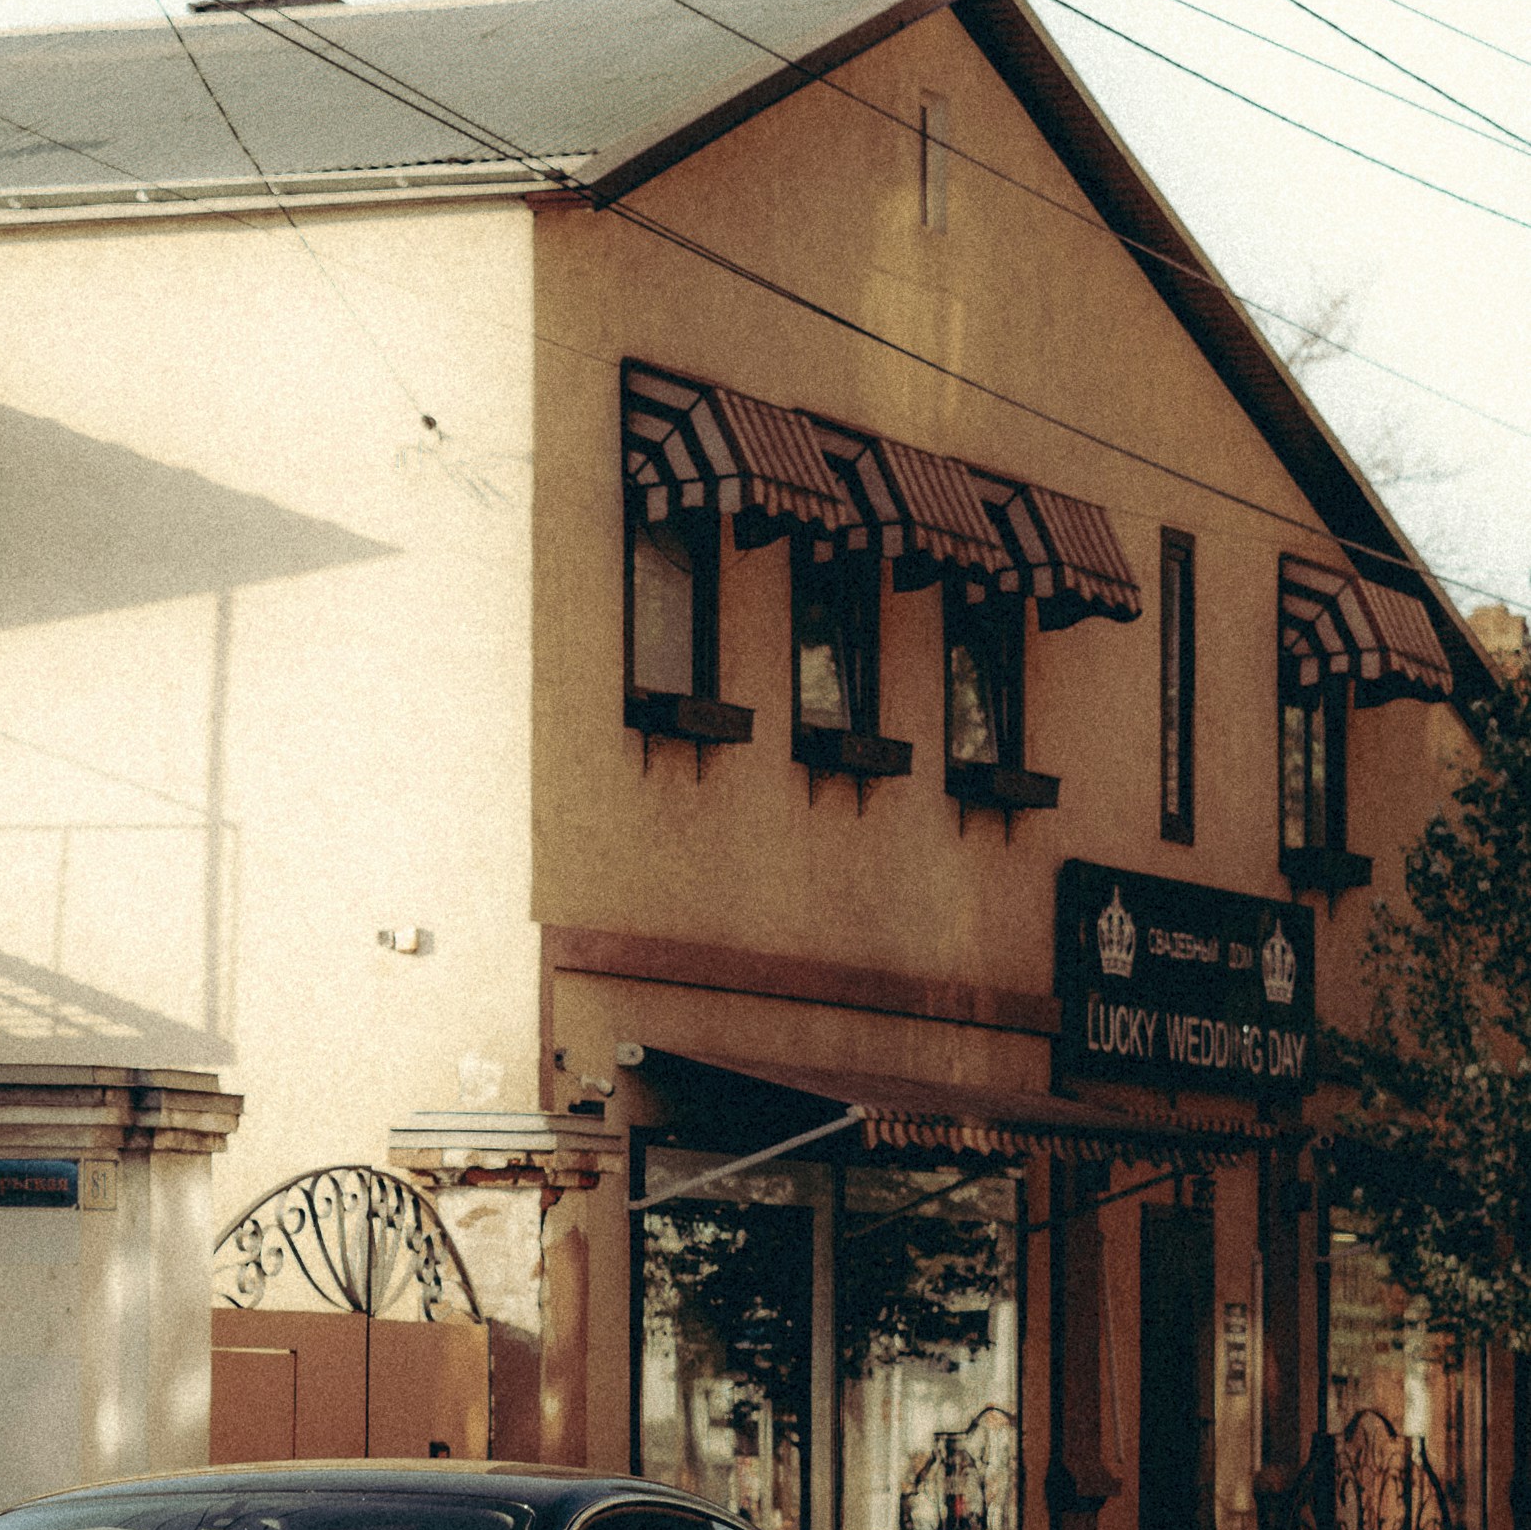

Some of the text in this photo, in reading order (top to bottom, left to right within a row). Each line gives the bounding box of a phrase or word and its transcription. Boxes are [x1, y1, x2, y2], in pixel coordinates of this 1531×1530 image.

[1088, 991, 1307, 1077] LUCKY WEDDING DAY
